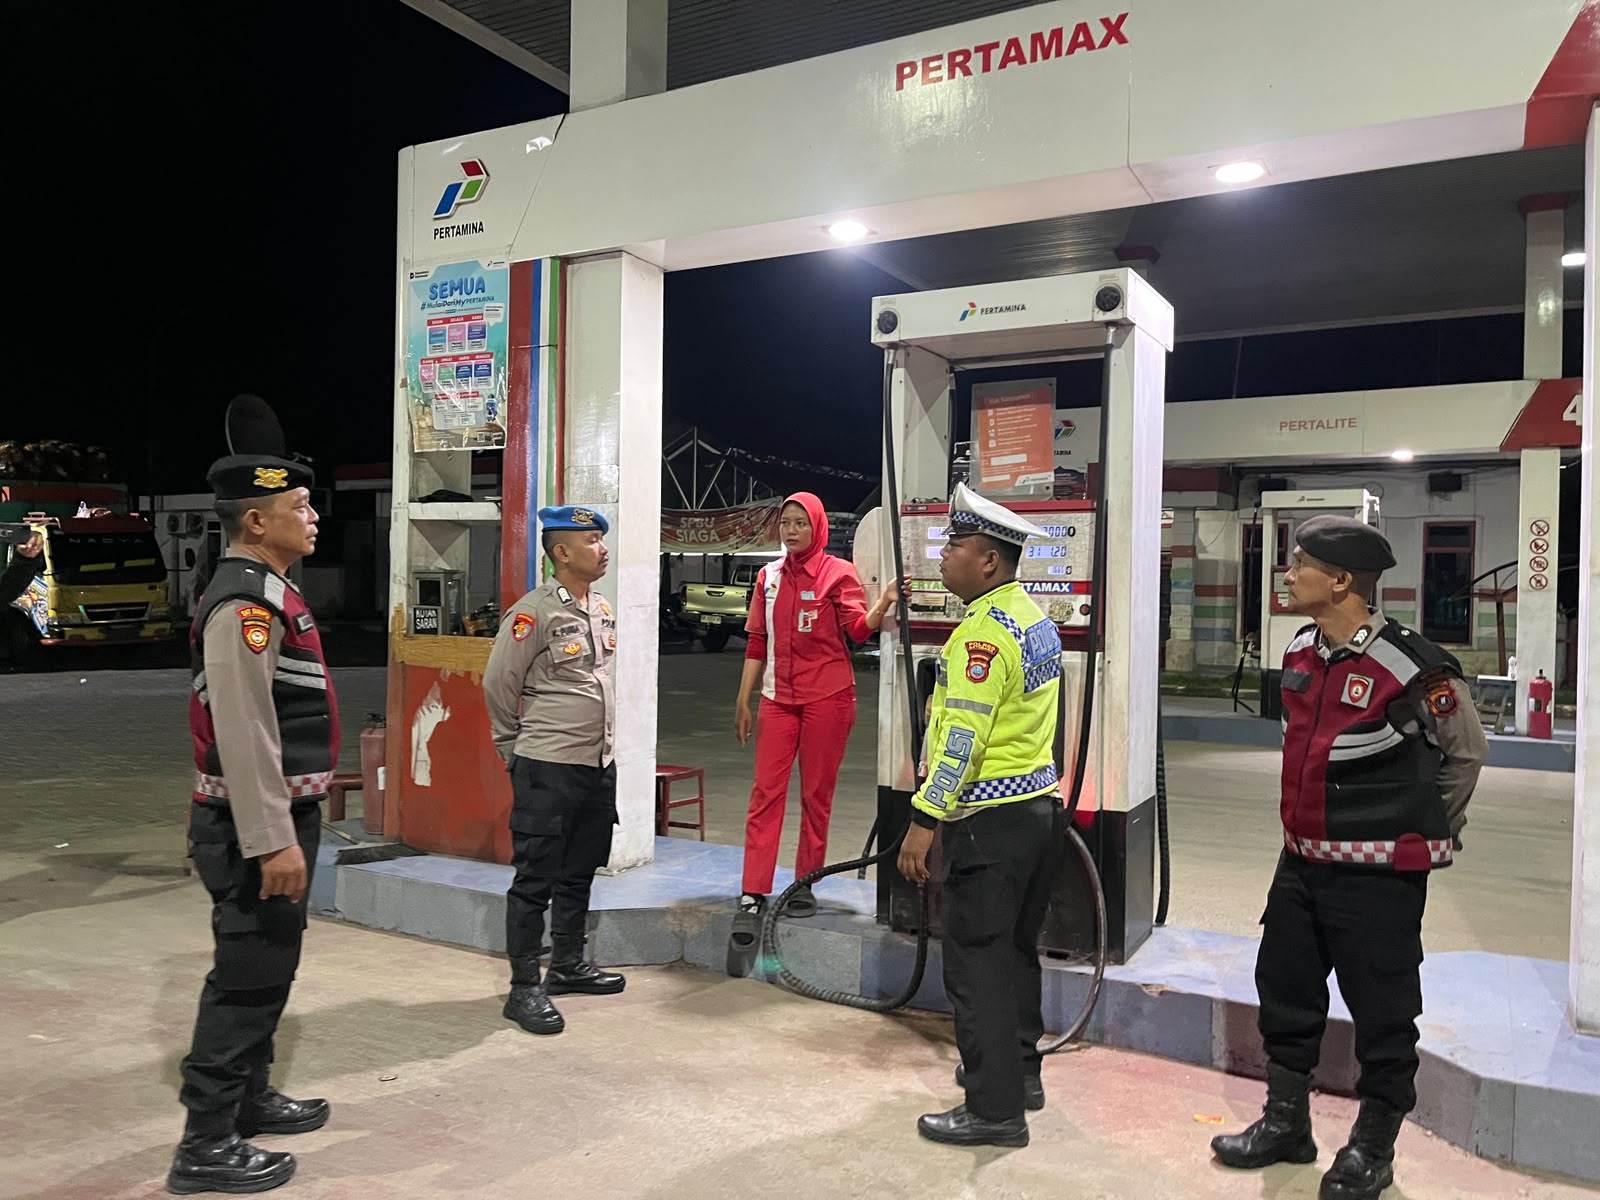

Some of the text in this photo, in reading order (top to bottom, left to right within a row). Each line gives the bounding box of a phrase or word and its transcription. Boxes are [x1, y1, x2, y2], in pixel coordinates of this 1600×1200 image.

[896, 12, 1129, 91] PERTAMAX
[434, 221, 484, 240] PERTAMINA
[429, 276, 486, 300] SEMUA
[980, 304, 1027, 315] PERTAMINA
[1563, 394, 1583, 427] 4
[1279, 417, 1358, 431] PERTALITE
[679, 517, 715, 528] SPBU
[676, 529, 721, 542] SIAGA
[416, 618, 437, 630] SARAN
[925, 726, 976, 809] POLISI
